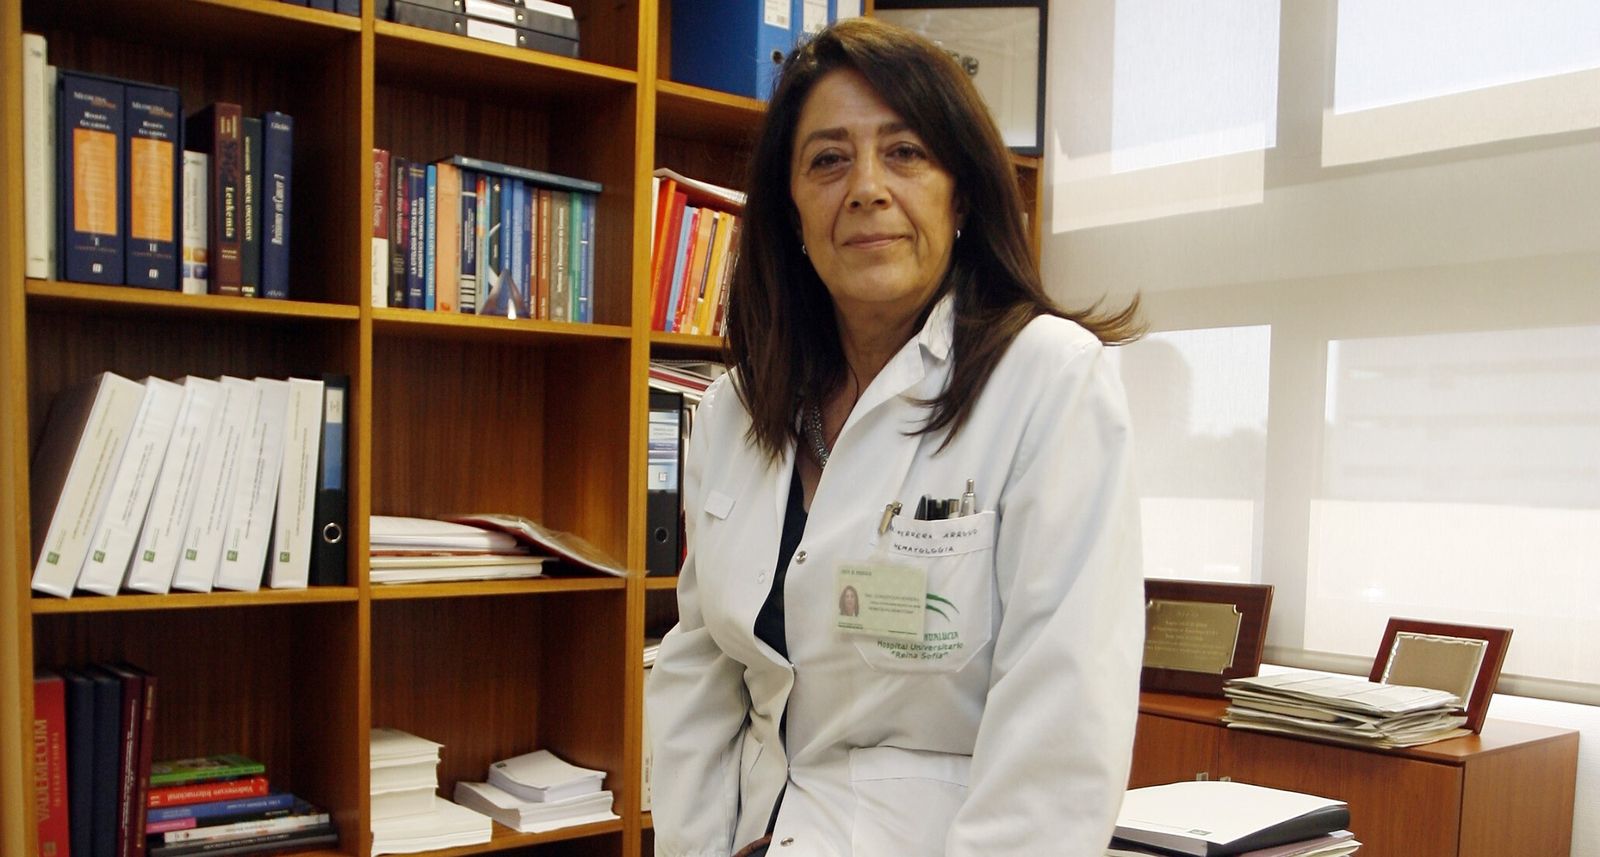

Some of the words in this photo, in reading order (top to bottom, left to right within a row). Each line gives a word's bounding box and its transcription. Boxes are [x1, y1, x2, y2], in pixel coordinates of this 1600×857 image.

[225, 186, 235, 238] Leukemia
[877, 640, 908, 650] Hospital
[910, 641, 964, 651] Universitario
